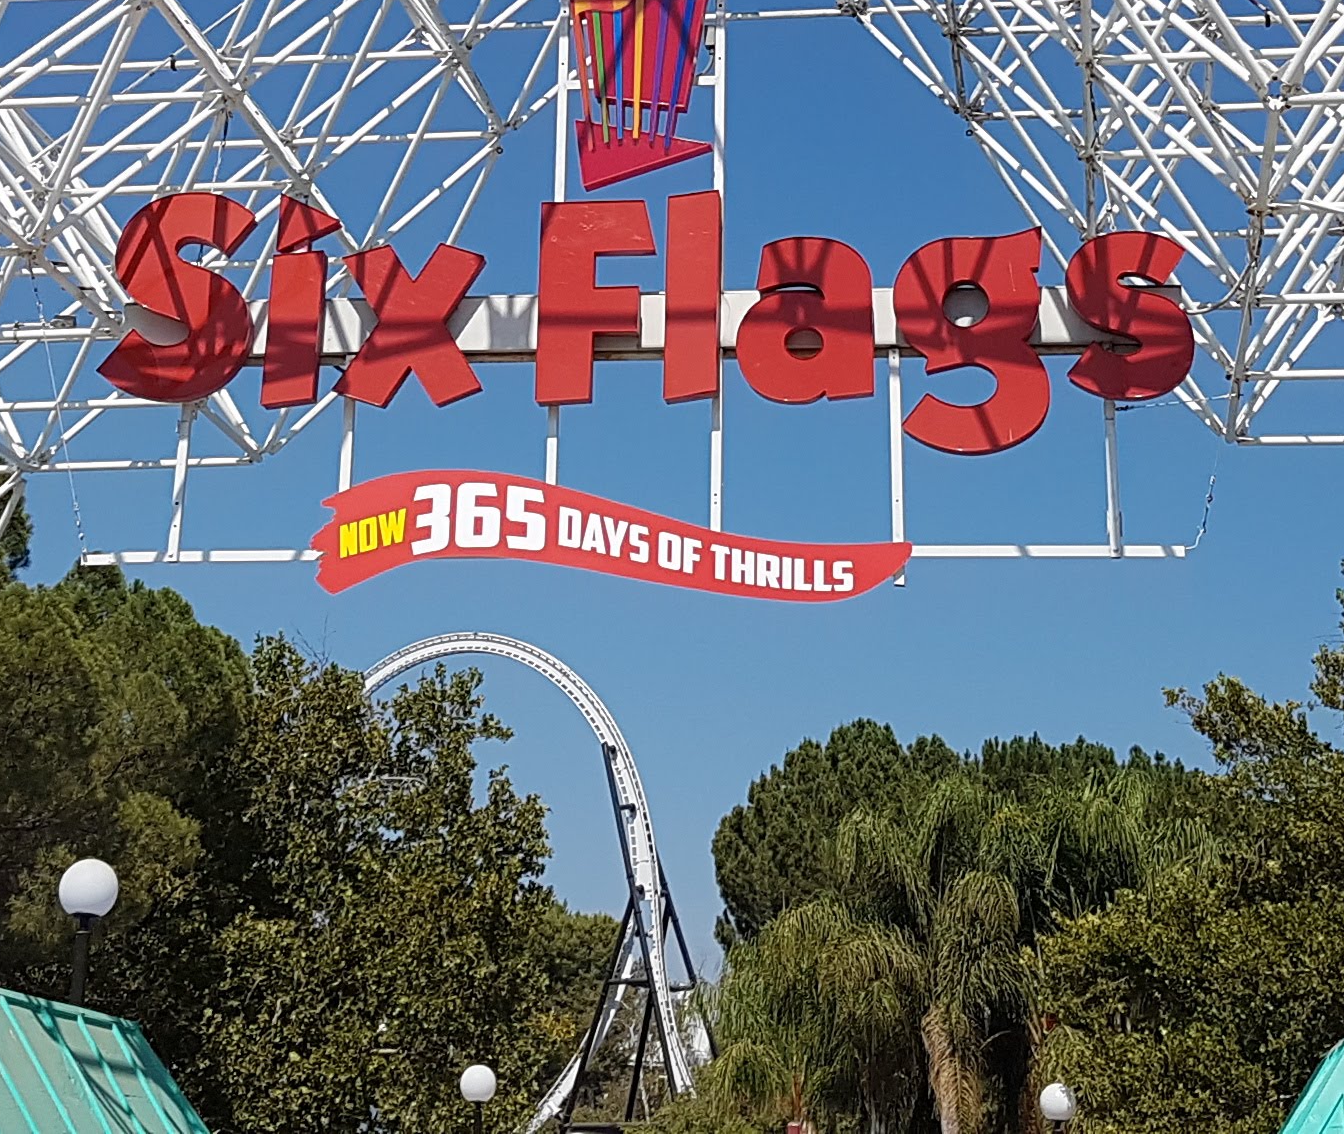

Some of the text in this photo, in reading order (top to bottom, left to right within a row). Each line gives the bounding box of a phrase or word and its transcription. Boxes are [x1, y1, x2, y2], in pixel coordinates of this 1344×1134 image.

[96, 189, 1195, 455] Six Flags
[338, 481, 855, 593] NOW 365 DAYS OF THRILLS
